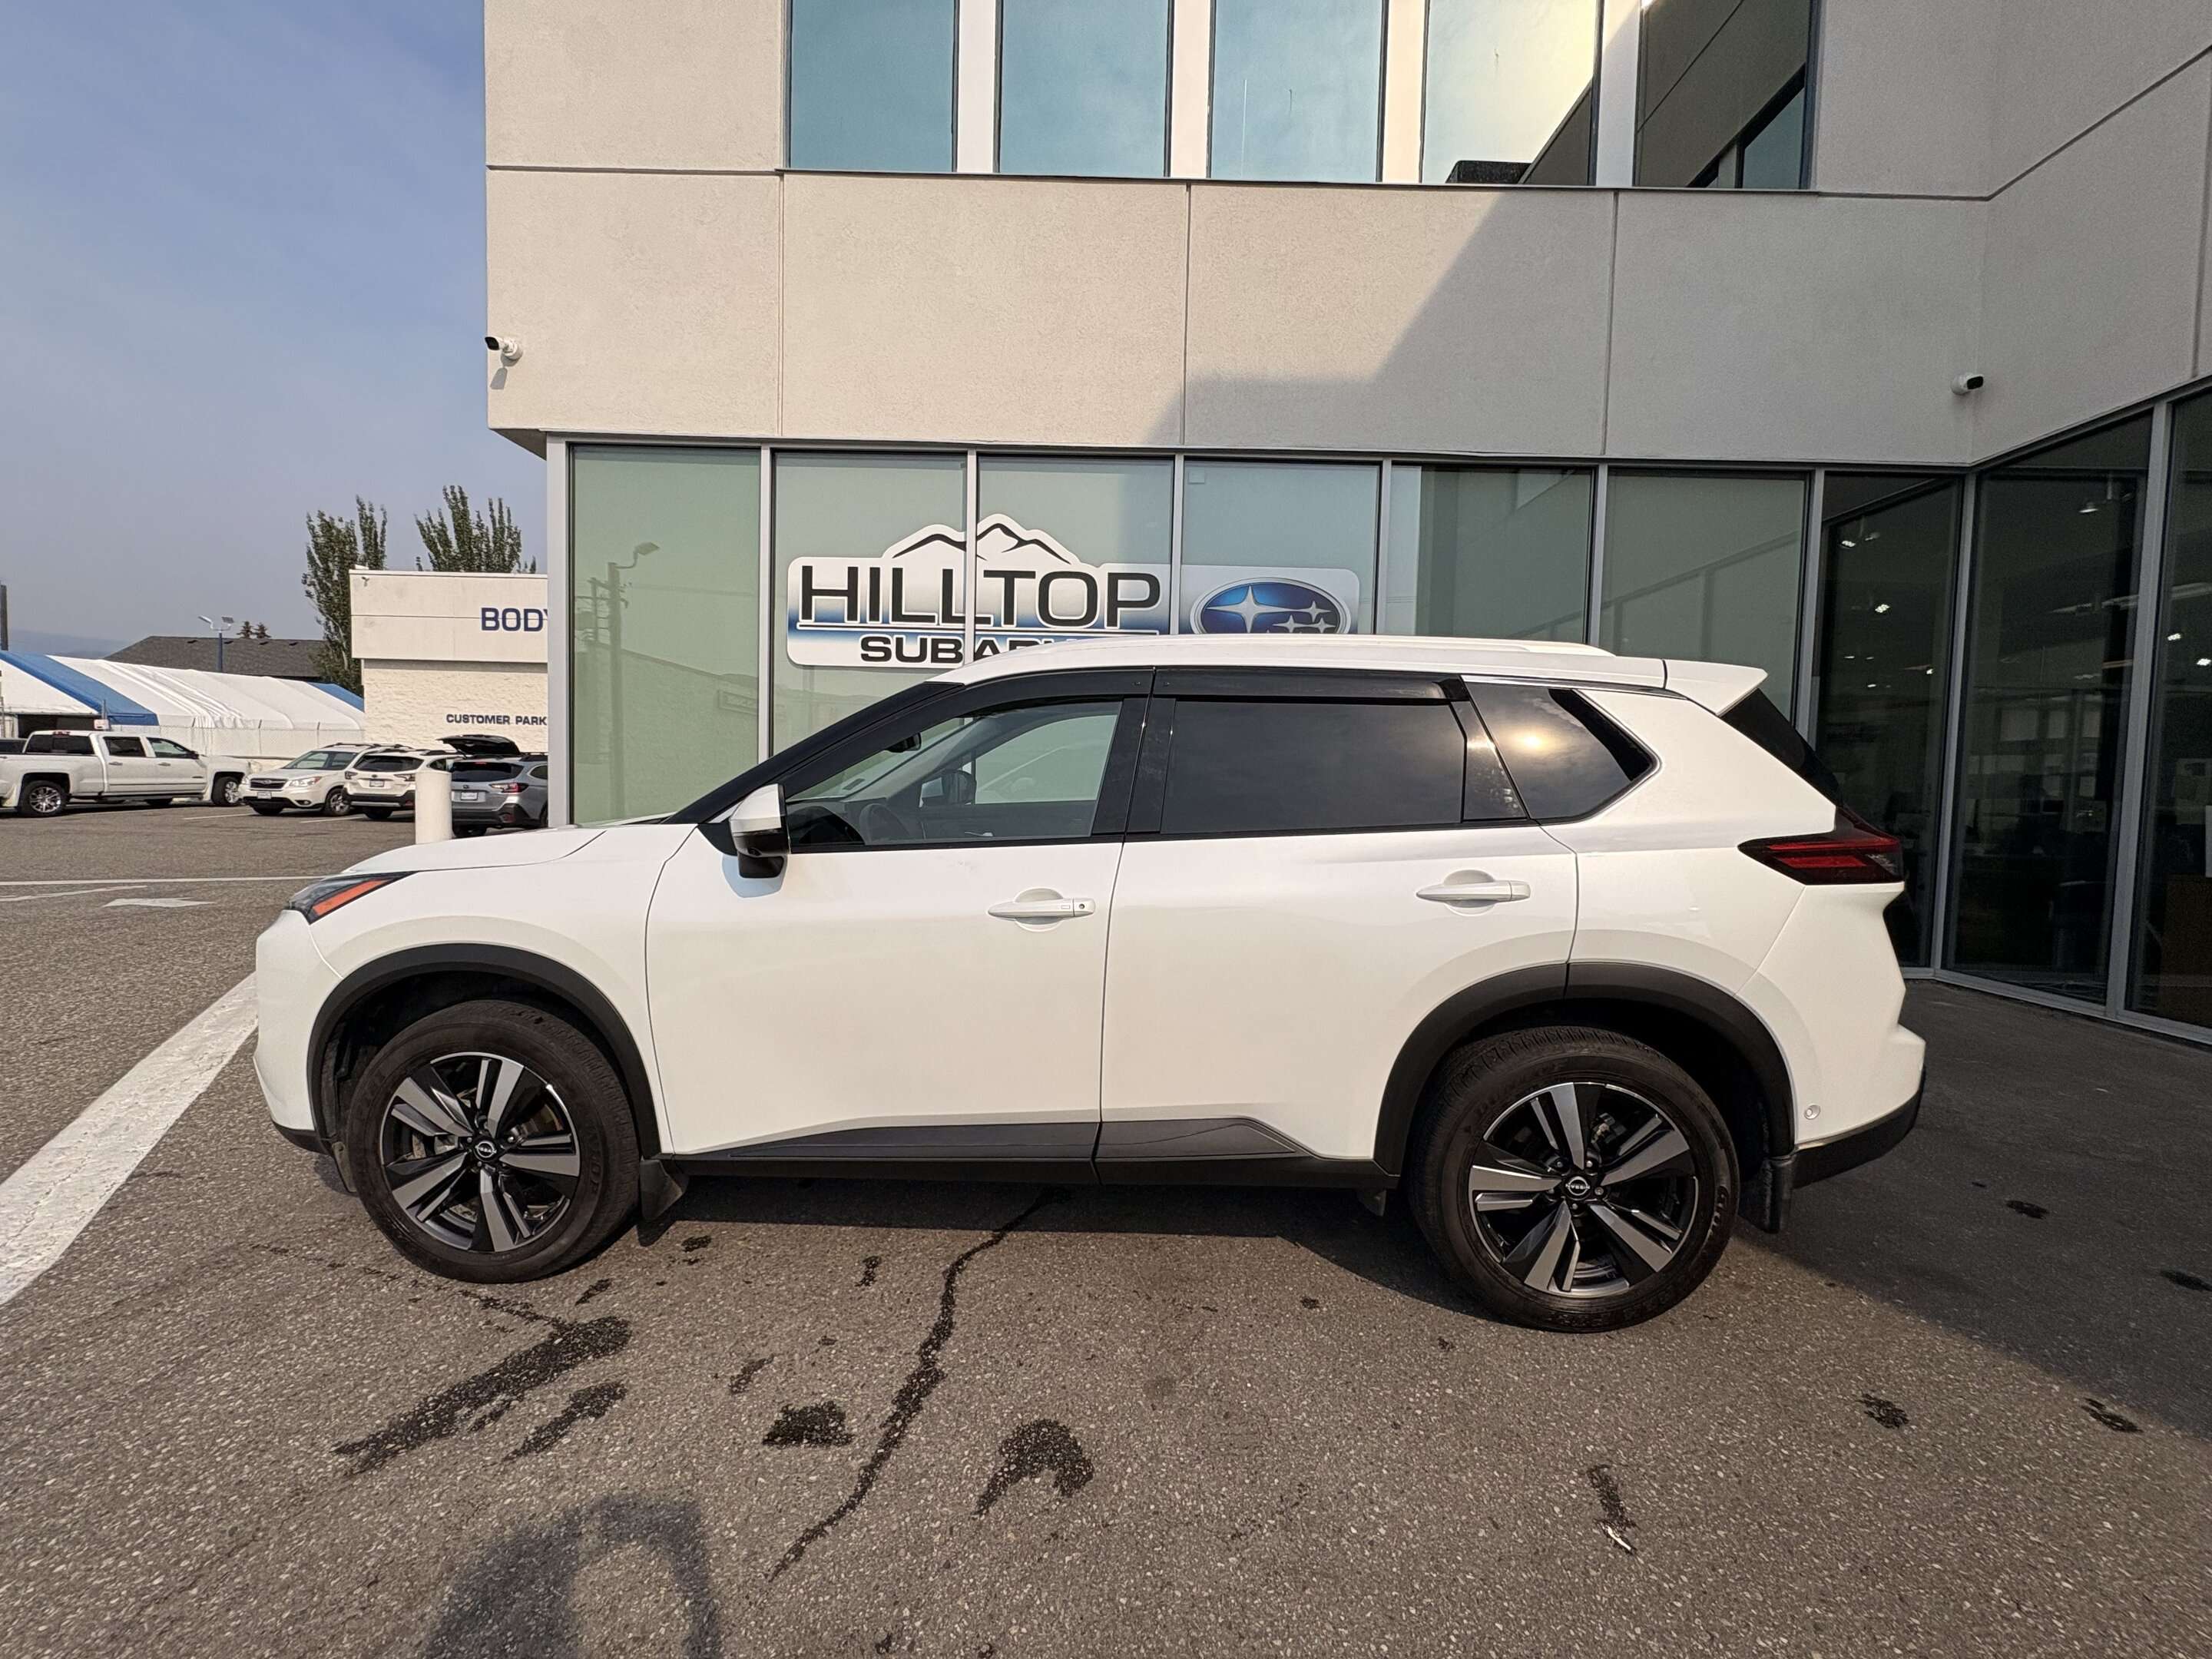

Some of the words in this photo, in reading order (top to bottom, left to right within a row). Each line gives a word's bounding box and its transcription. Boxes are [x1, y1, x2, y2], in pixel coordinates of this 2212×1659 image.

[801, 565, 1161, 628] HILLTOP
[481, 607, 548, 632] BOD
[860, 635, 1055, 664] SUBA
[445, 714, 511, 725] CUSTOMER
